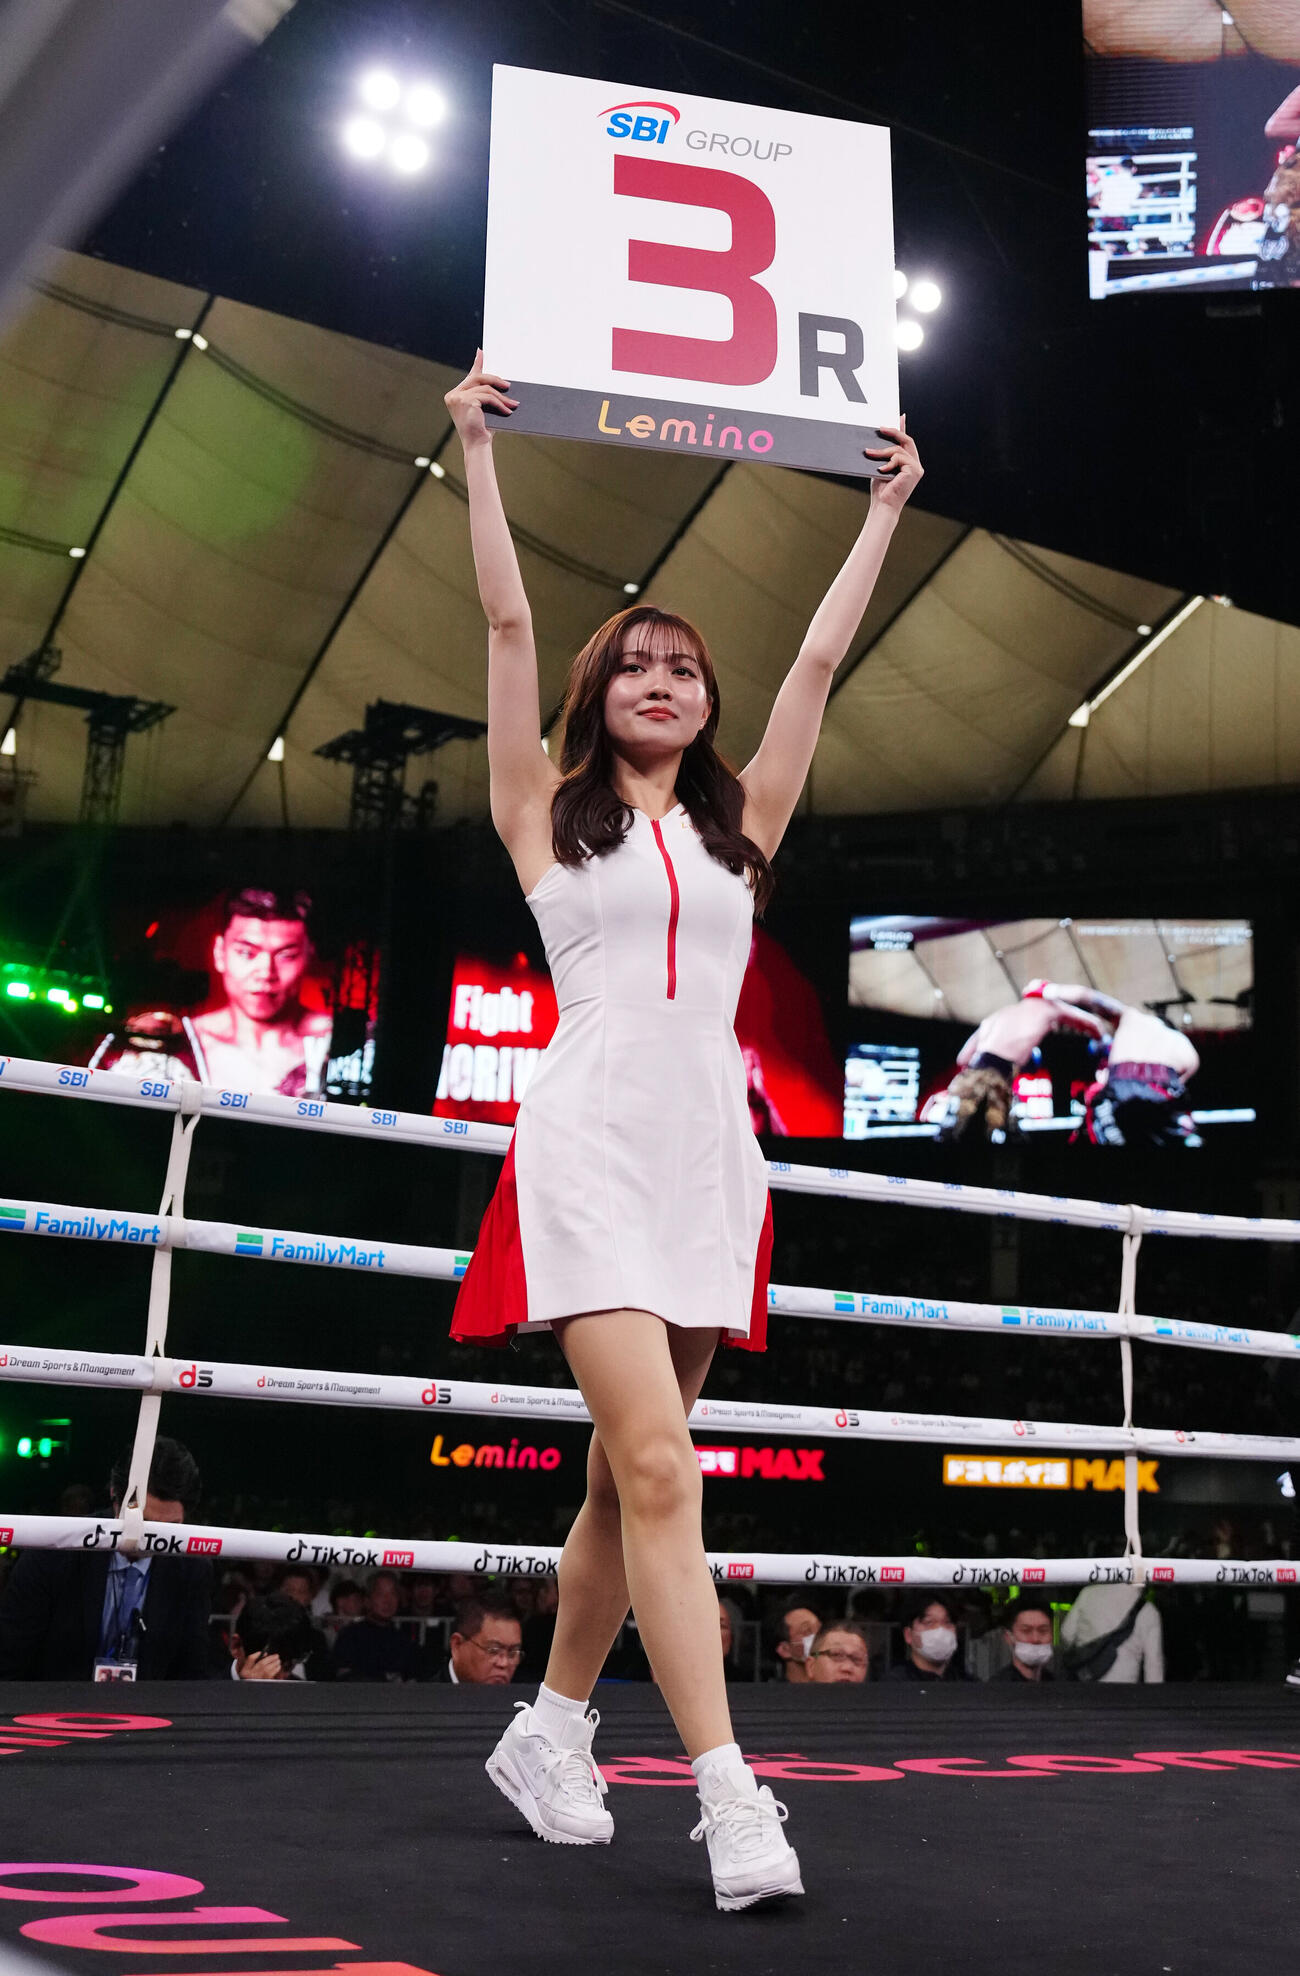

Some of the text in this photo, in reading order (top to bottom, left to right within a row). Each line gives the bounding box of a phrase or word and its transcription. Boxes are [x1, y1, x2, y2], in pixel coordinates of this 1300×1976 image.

[606, 112, 793, 162] SBI GROUP
[611, 154, 868, 404] 3 R
[597, 400, 774, 453] Lemino
[58, 1070, 468, 1135] SBI SBI SBI SBI SBI SBI
[34, 1212, 386, 1268] FamilyMart FamilyMart
[861, 1296, 949, 1320] FamilyMart
[9, 1356, 40, 1369] Dream
[42, 1359, 72, 1373] Sports
[79, 1362, 135, 1376] Management
[267, 1377, 295, 1389] Dream
[296, 1380, 323, 1392] Sports
[330, 1382, 381, 1395] Management
[556, 1397, 585, 1408] Manage
[430, 1434, 562, 1470] Lemino
[741, 1447, 825, 1481] MAX
[1072, 1458, 1160, 1493] MAX
[110, 1530, 558, 1575] TTok LIVE TikTok LIVE TikTok
[730, 1565, 752, 1578] LIVE
[824, 1565, 877, 1582] TikTok
[882, 1568, 903, 1580] LIVE
[969, 1567, 1019, 1583] TikTok
[1024, 1569, 1044, 1581] LIVE
[1231, 1567, 1273, 1583] TikTok
[593, 1750, 1300, 1786] docom
